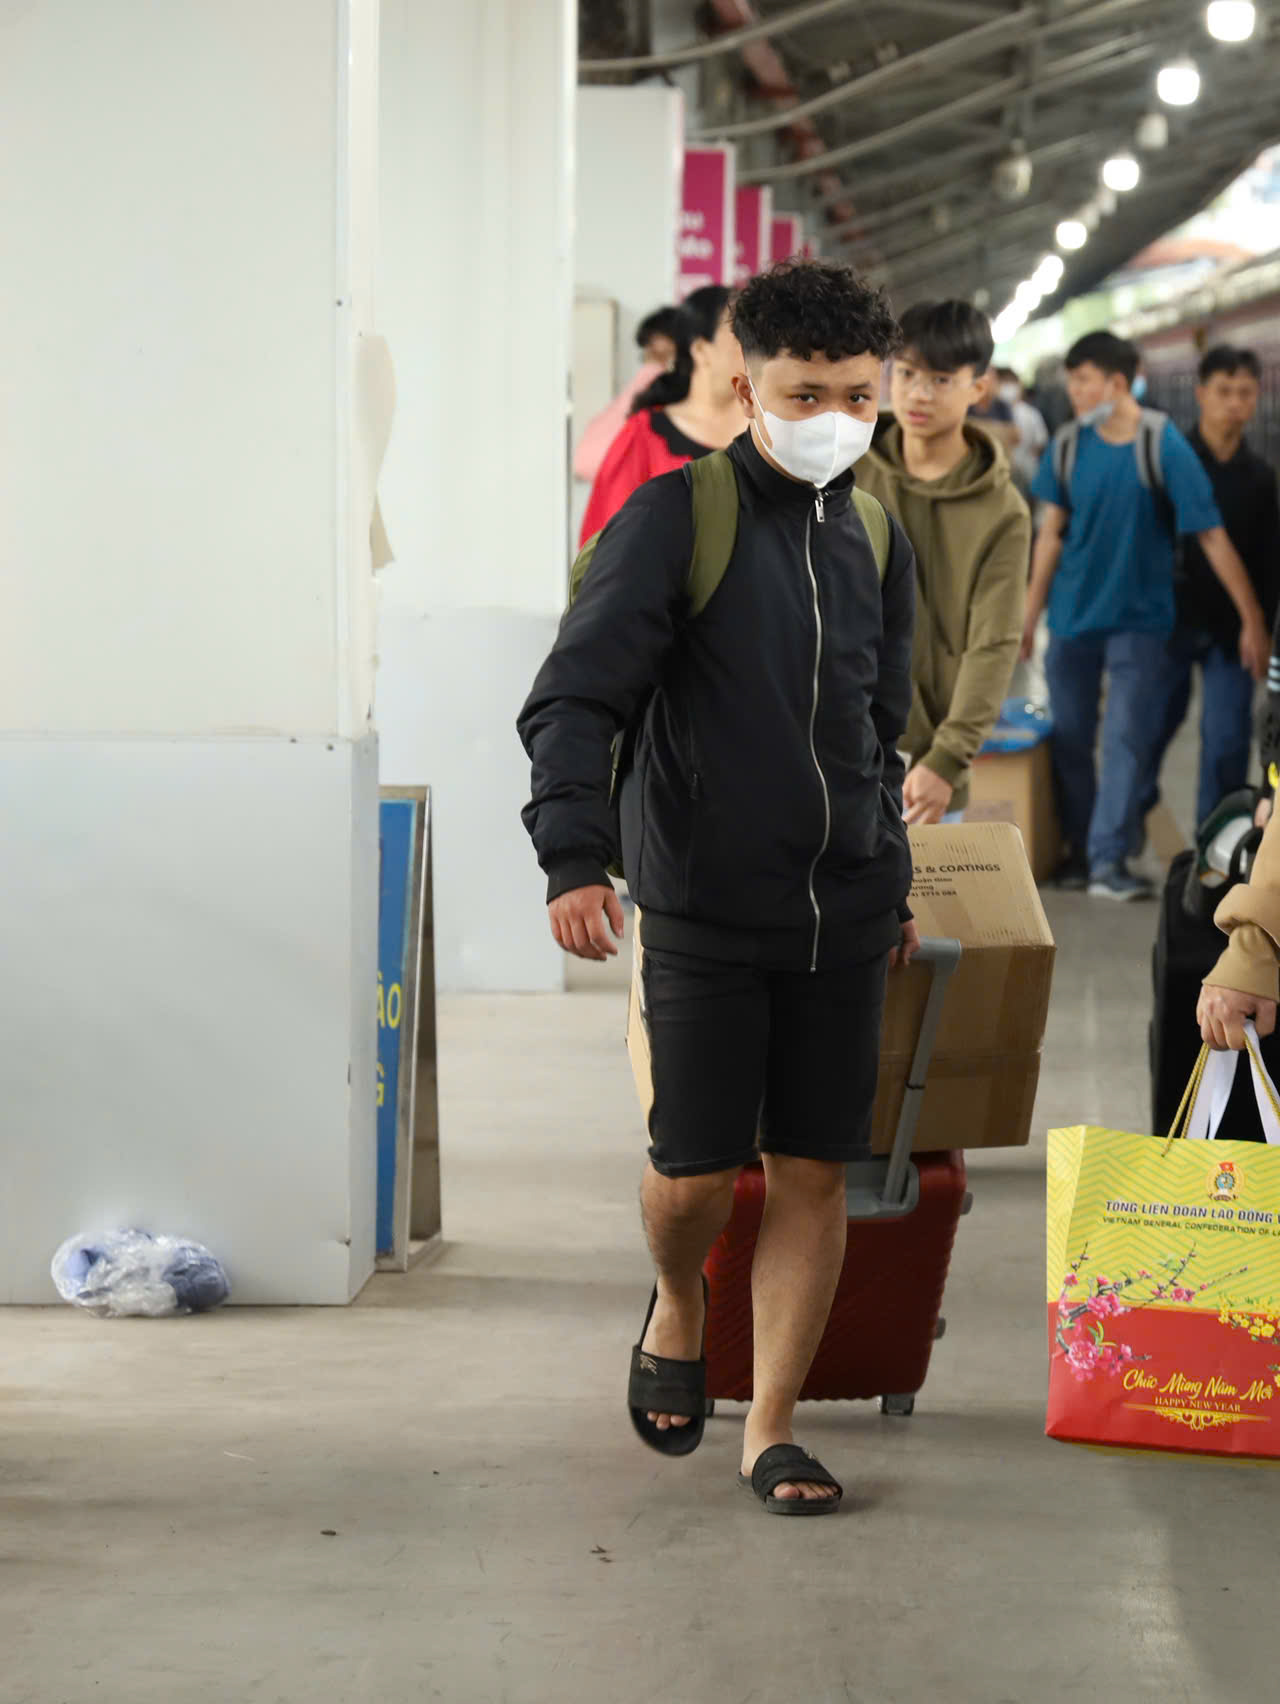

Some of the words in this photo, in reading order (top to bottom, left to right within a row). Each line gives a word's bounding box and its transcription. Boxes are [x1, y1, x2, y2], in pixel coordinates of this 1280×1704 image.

[939, 864, 1001, 872] COATINGS
[1211, 1208, 1234, 1220] LAO
[1103, 1216, 1141, 1226] VIETNAM
[1143, 1219, 1181, 1229] GENERAL
[1184, 1222, 1256, 1235] CONFEDERATION
[1155, 1396, 1187, 1408] HAPPY
[1190, 1400, 1213, 1409] NEW
[1214, 1402, 1241, 1412] YEAR
